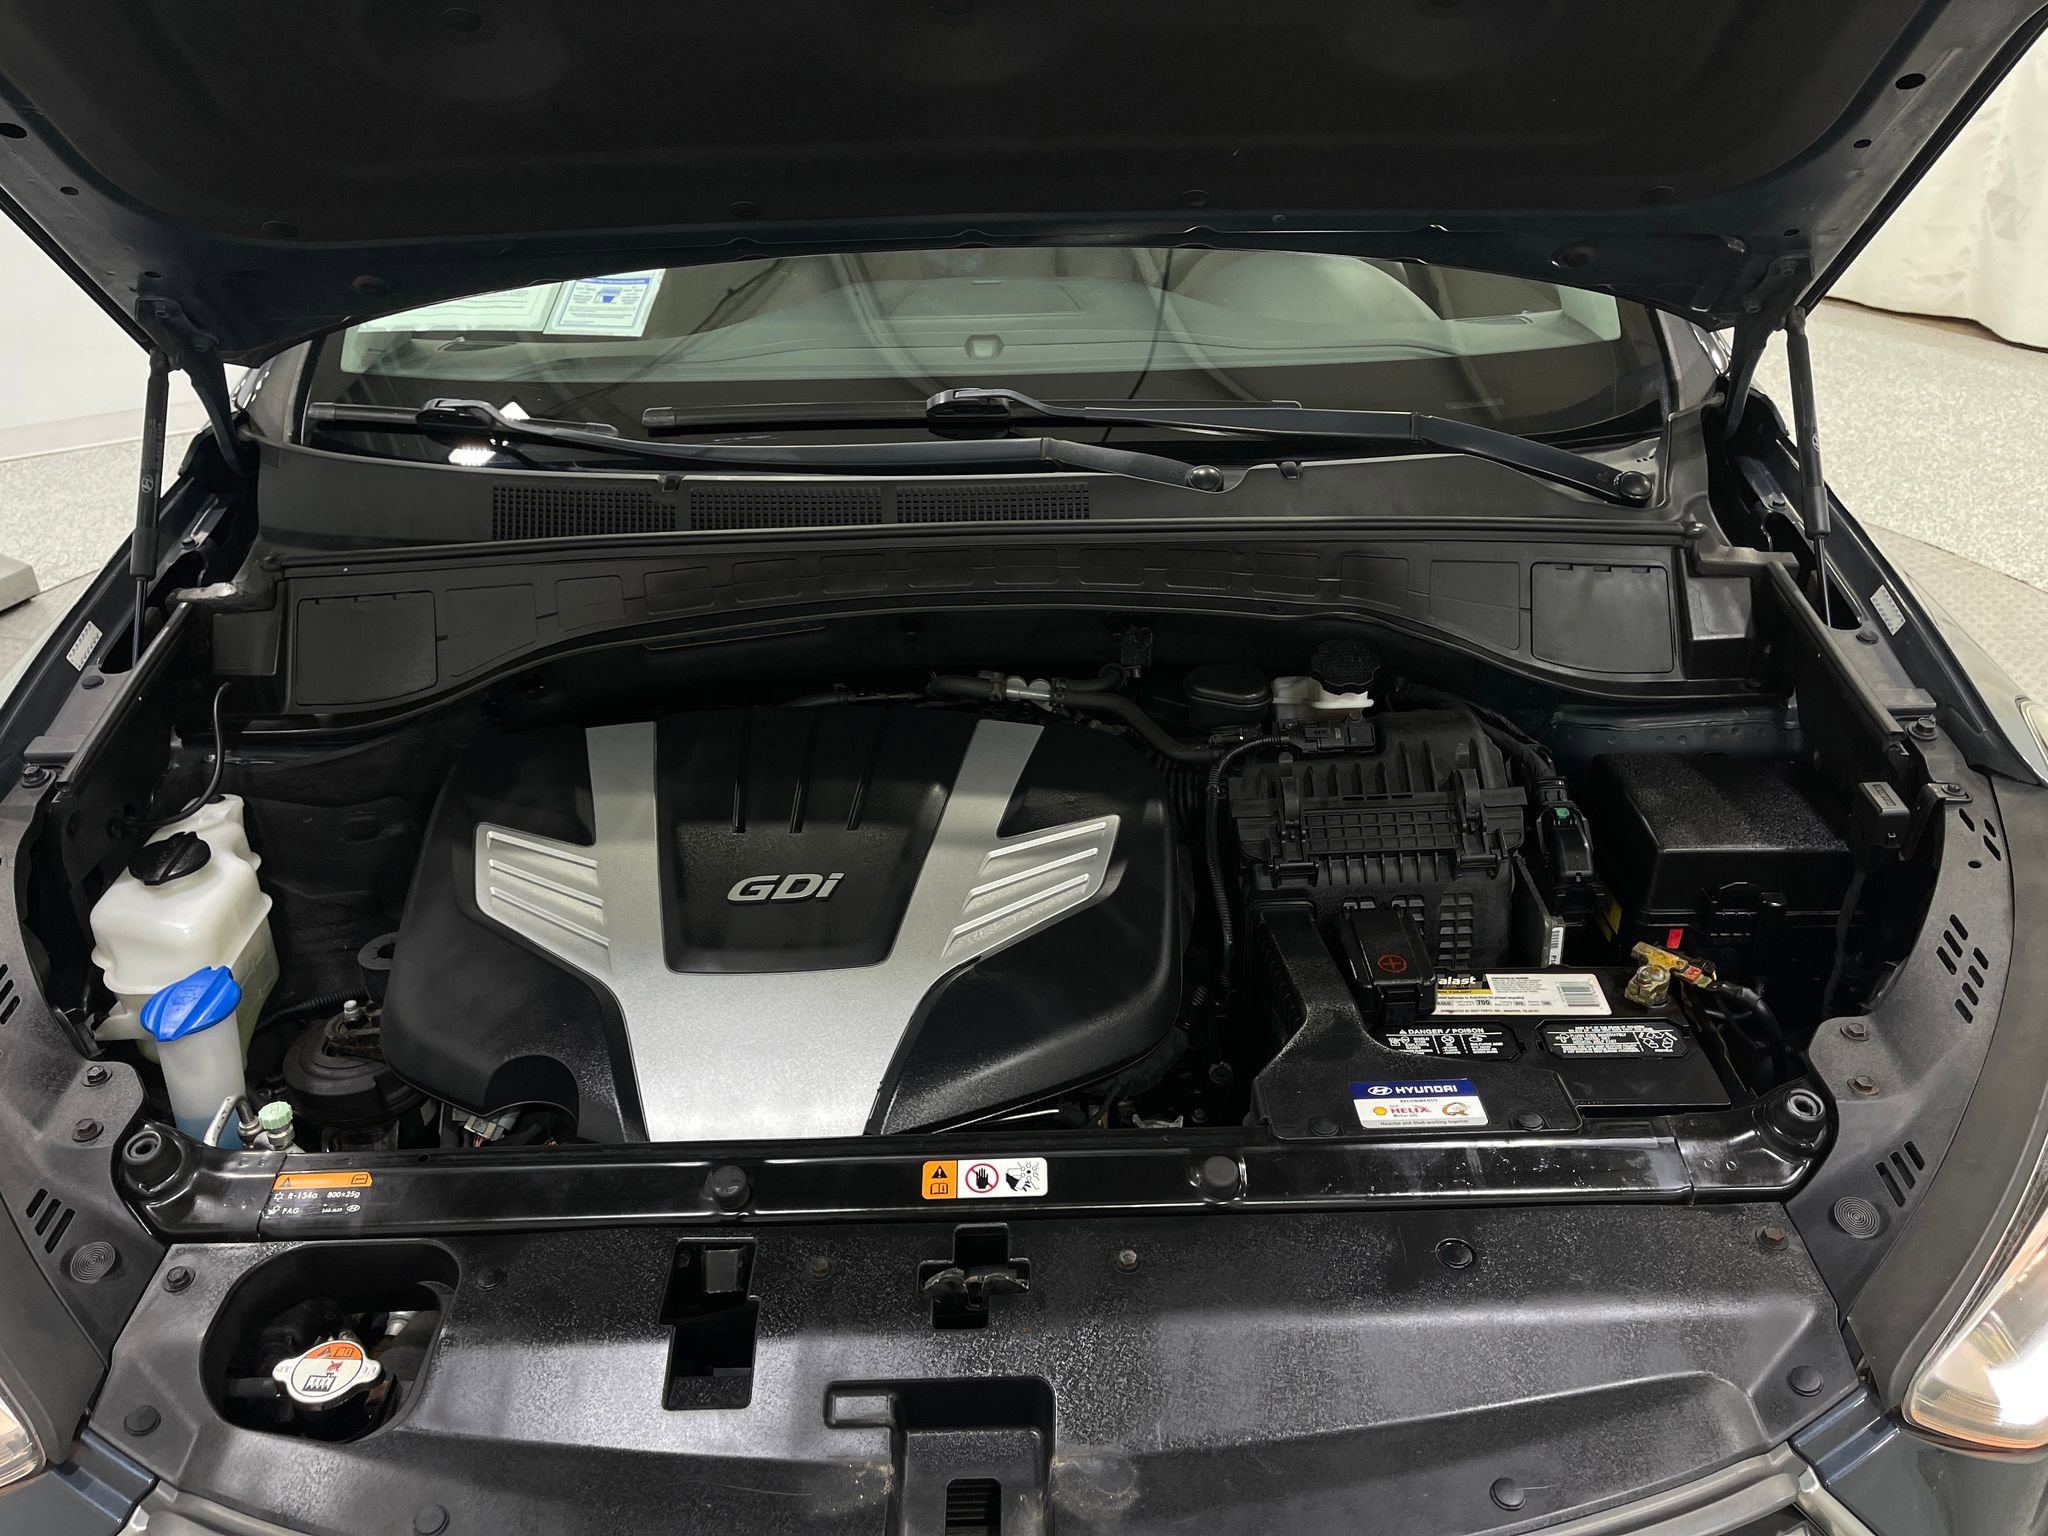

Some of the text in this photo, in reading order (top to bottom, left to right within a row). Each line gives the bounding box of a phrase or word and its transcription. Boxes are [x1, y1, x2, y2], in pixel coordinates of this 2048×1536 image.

[727, 873, 845, 901] GDi
[1437, 976, 1476, 985] alast
[1395, 1085, 1458, 1094] HYUNDAI
